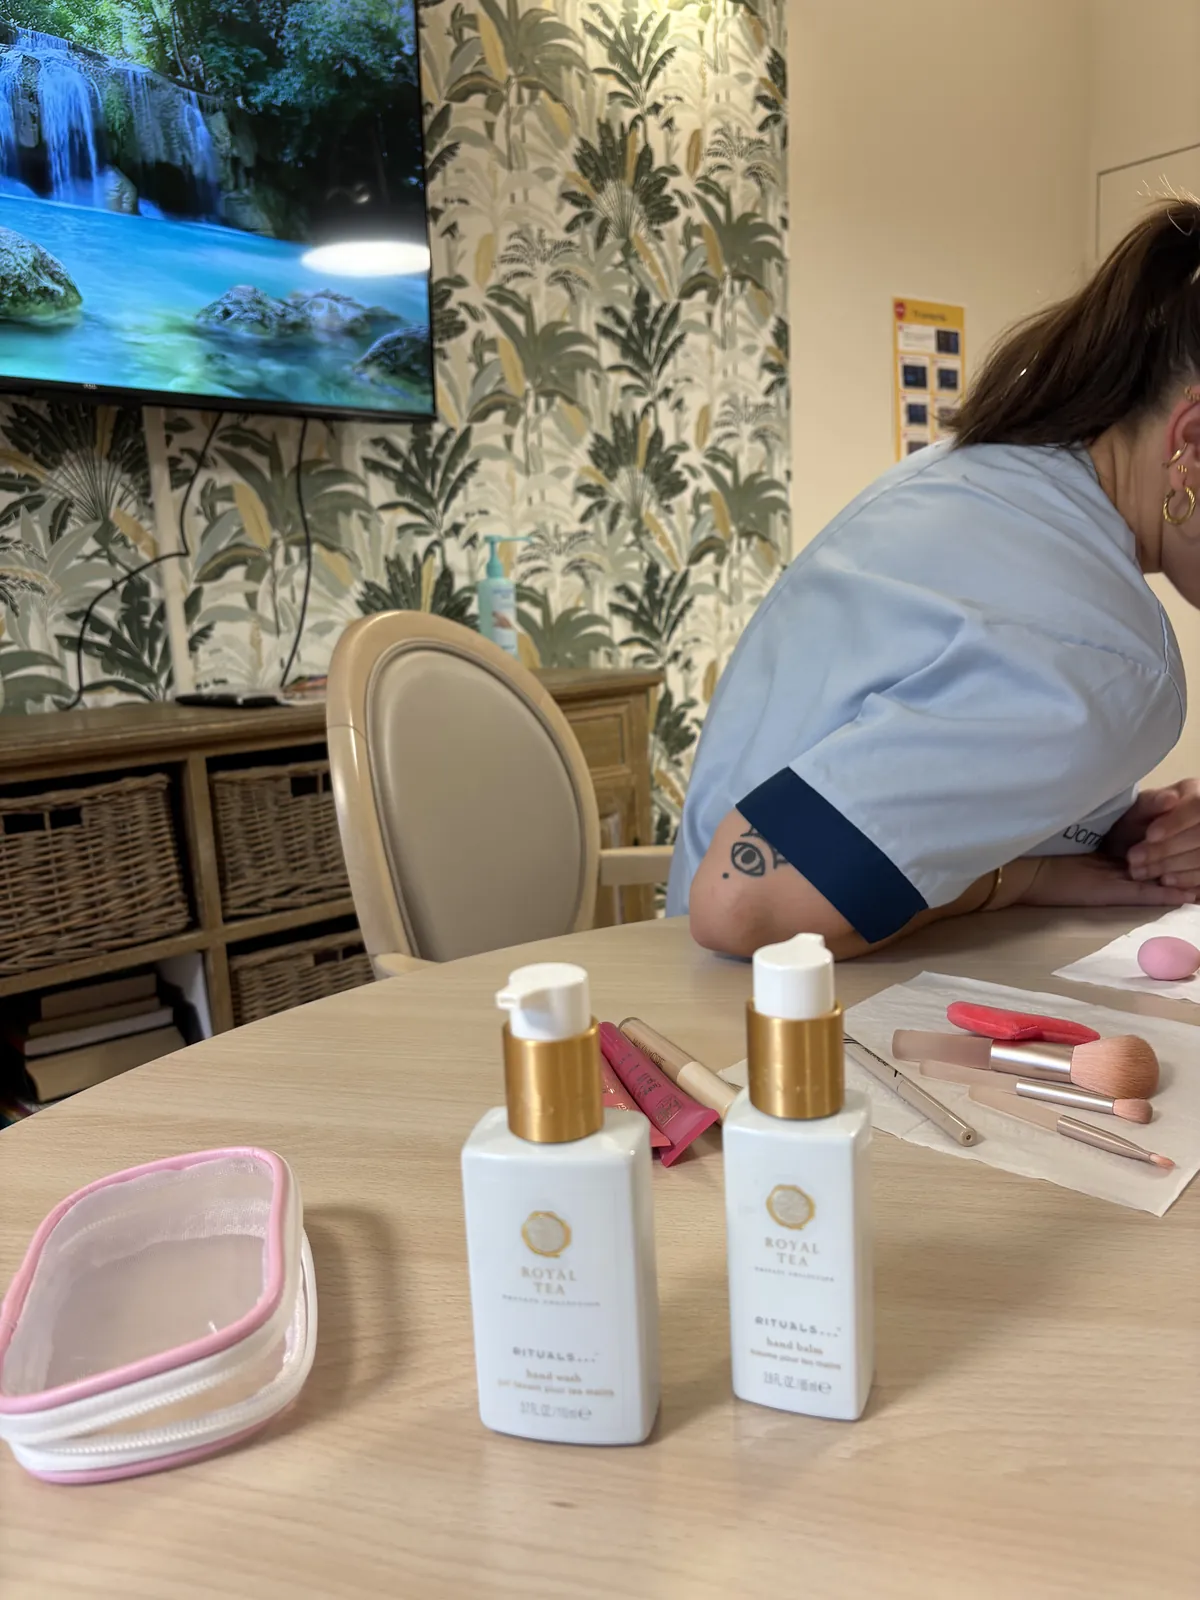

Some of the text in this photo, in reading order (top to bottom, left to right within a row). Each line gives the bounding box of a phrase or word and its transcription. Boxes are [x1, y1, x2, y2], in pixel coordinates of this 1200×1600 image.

[763, 1236, 821, 1255] ROYAL
[776, 1251, 809, 1267] TEA
[520, 1265, 578, 1282] ROYAL
[532, 1281, 566, 1296] TEA
[765, 1335, 825, 1356] hand balm
[525, 1368, 582, 1383] hand wash
